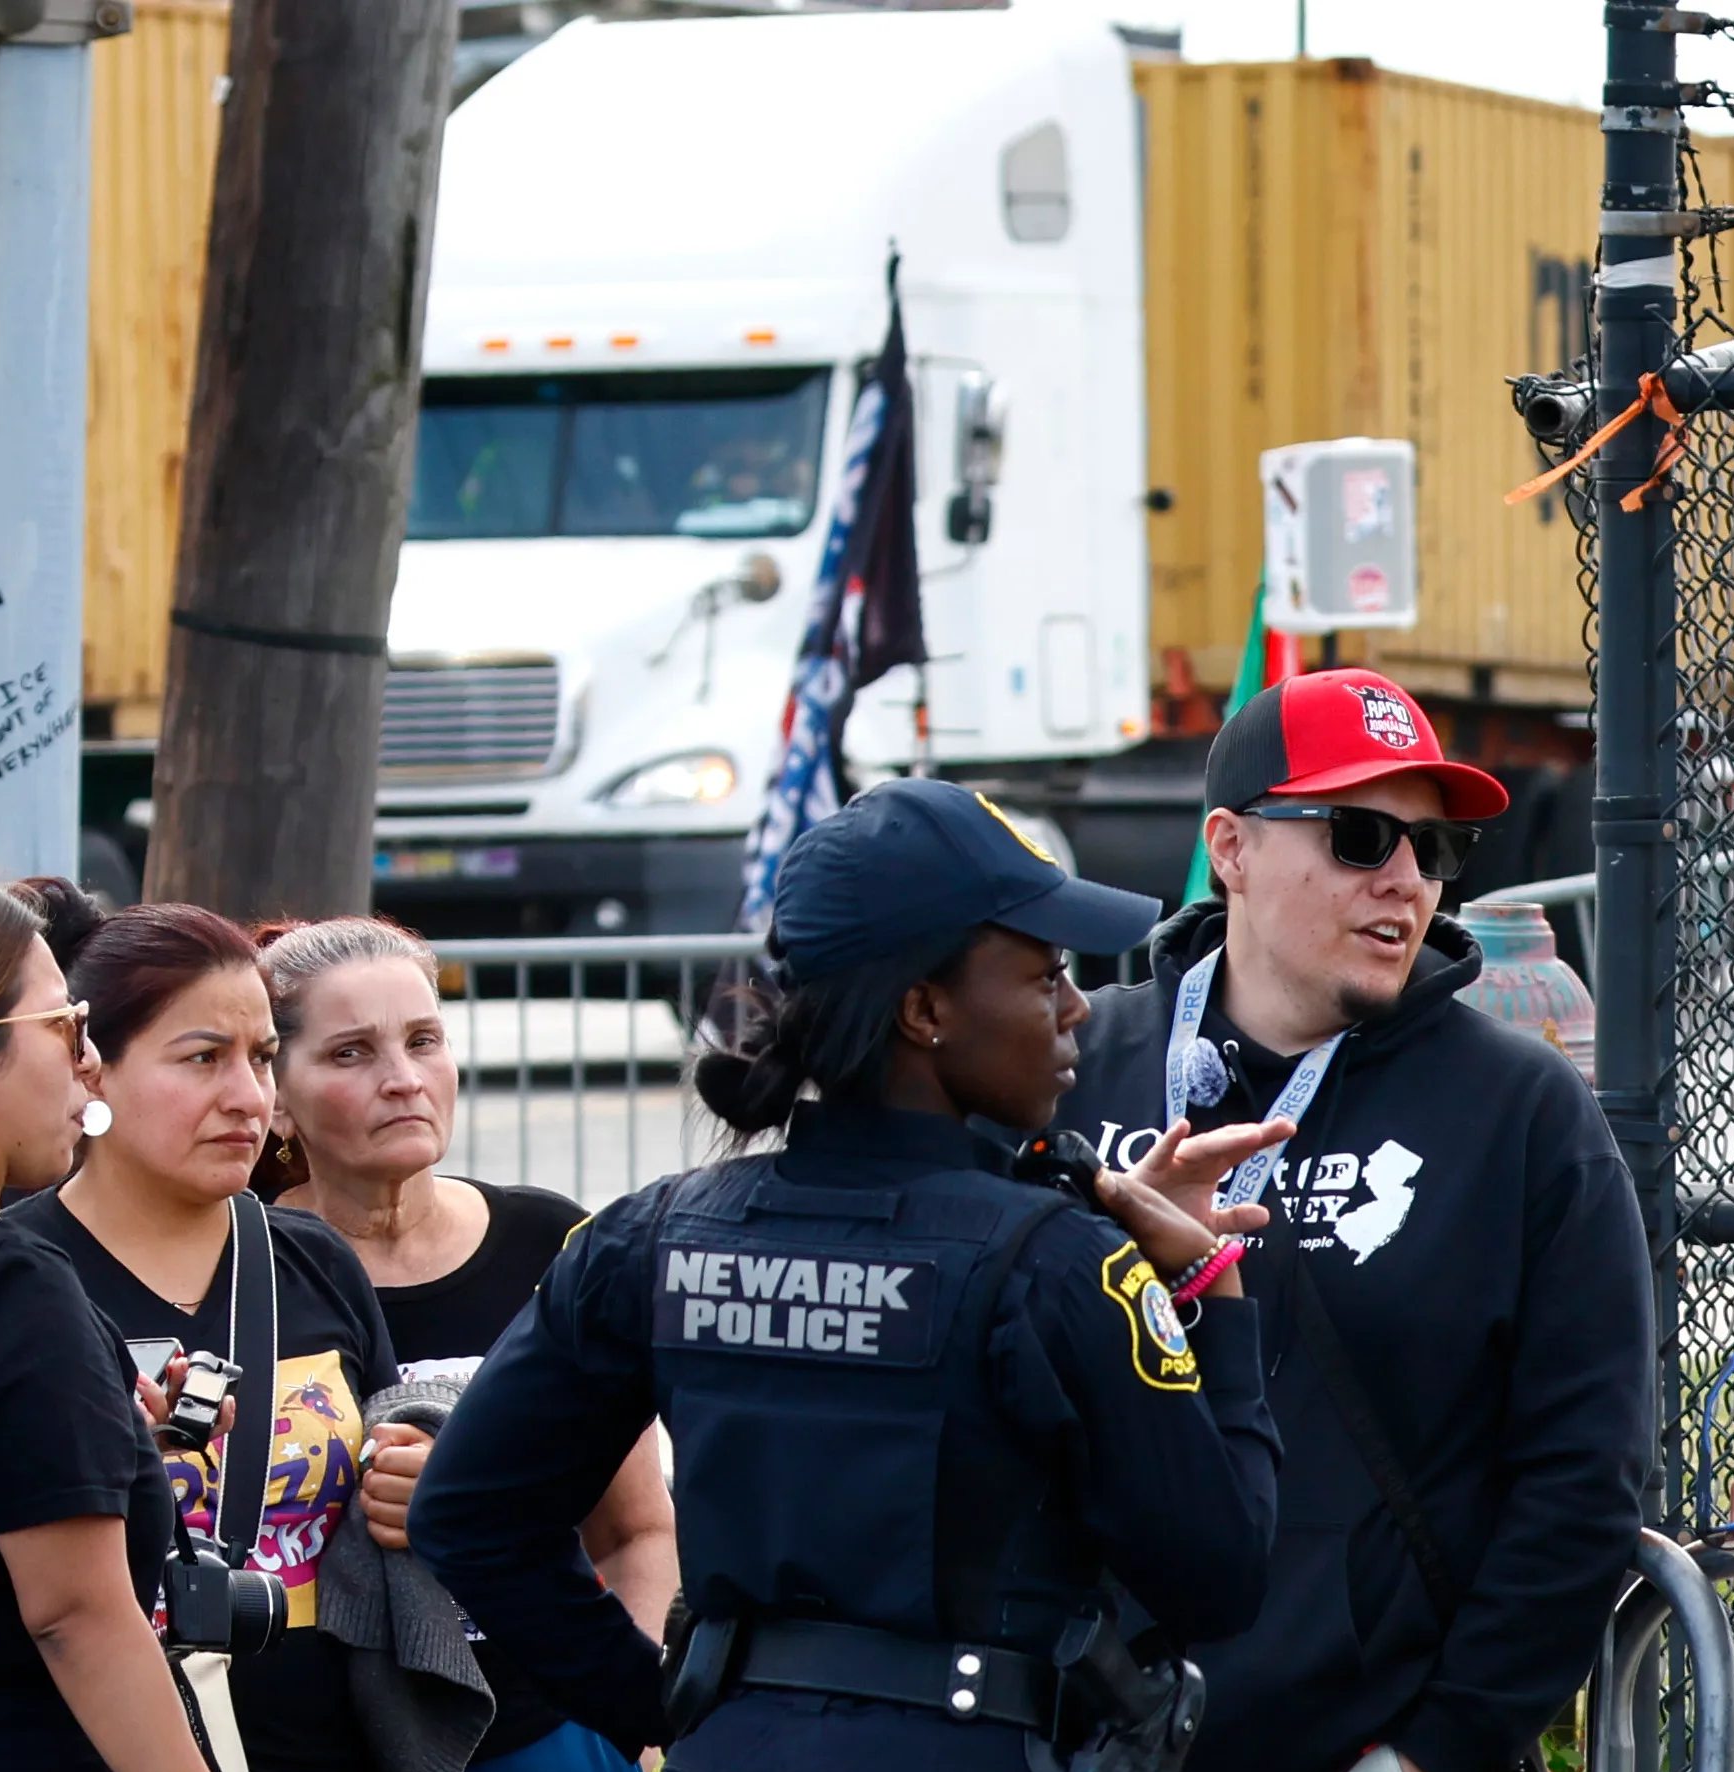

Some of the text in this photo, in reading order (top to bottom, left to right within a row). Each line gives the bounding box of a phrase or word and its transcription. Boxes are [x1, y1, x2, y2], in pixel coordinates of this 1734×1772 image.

[34, 686, 56, 717] OF
[1366, 700, 1410, 724] RADIO
[1229, 1152, 1267, 1209] RESS
[665, 1250, 914, 1311] NEWARK
[683, 1298, 881, 1355] POLICE
[163, 1438, 356, 1519] PIZA
